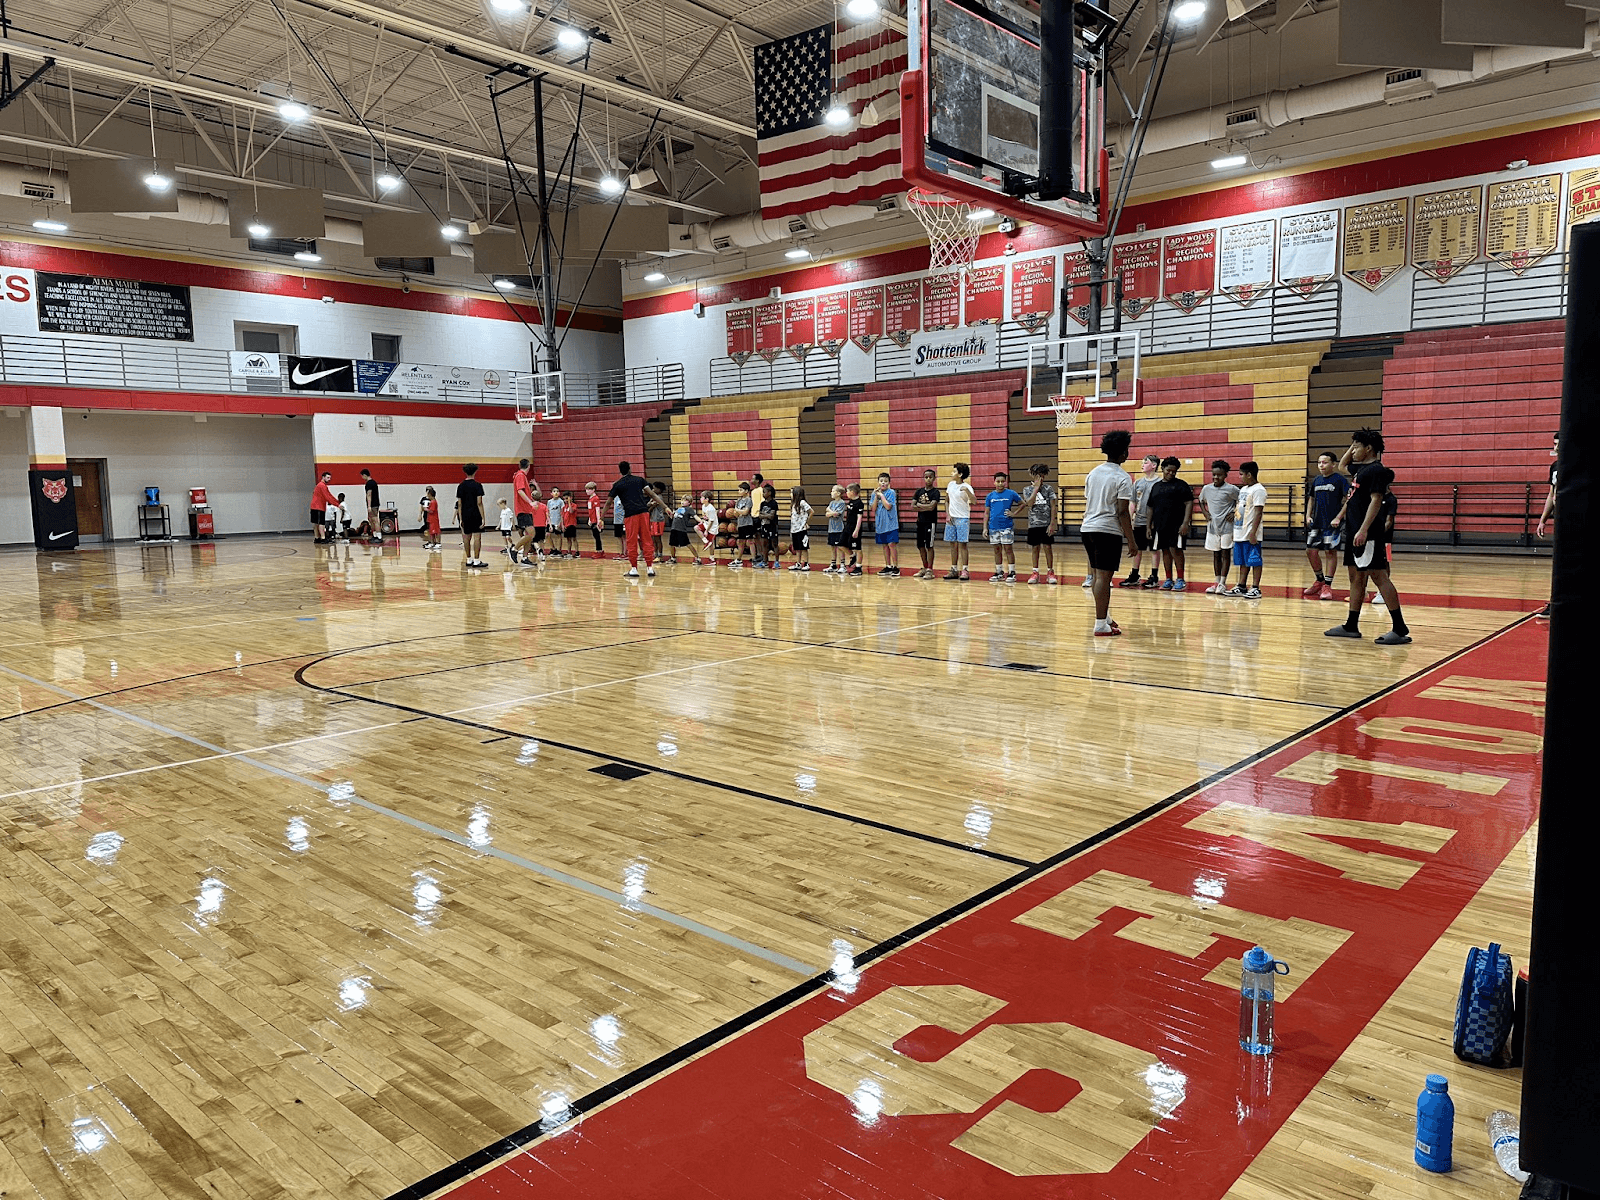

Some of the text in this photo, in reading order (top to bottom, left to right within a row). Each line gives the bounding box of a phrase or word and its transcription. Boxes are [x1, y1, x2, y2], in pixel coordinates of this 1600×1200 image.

[1499, 178, 1550, 192] STATE
[1424, 190, 1471, 205] STATE
[1494, 187, 1555, 202] INDIVIDUAL
[1419, 198, 1476, 213] INDIVIDUAL
[1490, 194, 1557, 210] CHAMPIONS
[1355, 203, 1398, 216] STATE
[1416, 206, 1478, 221] CHAMPIONS
[1290, 213, 1331, 226] STATE
[1350, 210, 1402, 224] INDIVIDUAL
[1230, 224, 1268, 236] STATE
[1283, 221, 1337, 237] RUNNER-UP
[1347, 217, 1405, 232] CHAMPIONS
[1188, 232, 1214, 241] WOLVES
[1115, 242, 1158, 252] WOLVES
[1176, 247, 1204, 256] REGION
[1123, 256, 1149, 264] REGION
[1167, 252, 1213, 264] CHAMPIONS
[1014, 259, 1052, 270] WOLVES
[1014, 277, 1052, 287] CHAMPIONS
[1020, 272, 1044, 281] REGION
[887, 282, 919, 290] WOLVES
[967, 285, 1003, 295] CHAMPIONS
[887, 298, 919, 307] CHAMPIONS
[925, 292, 958, 301] CHAMPIONS
[916, 338, 989, 365] Shottenkirk
